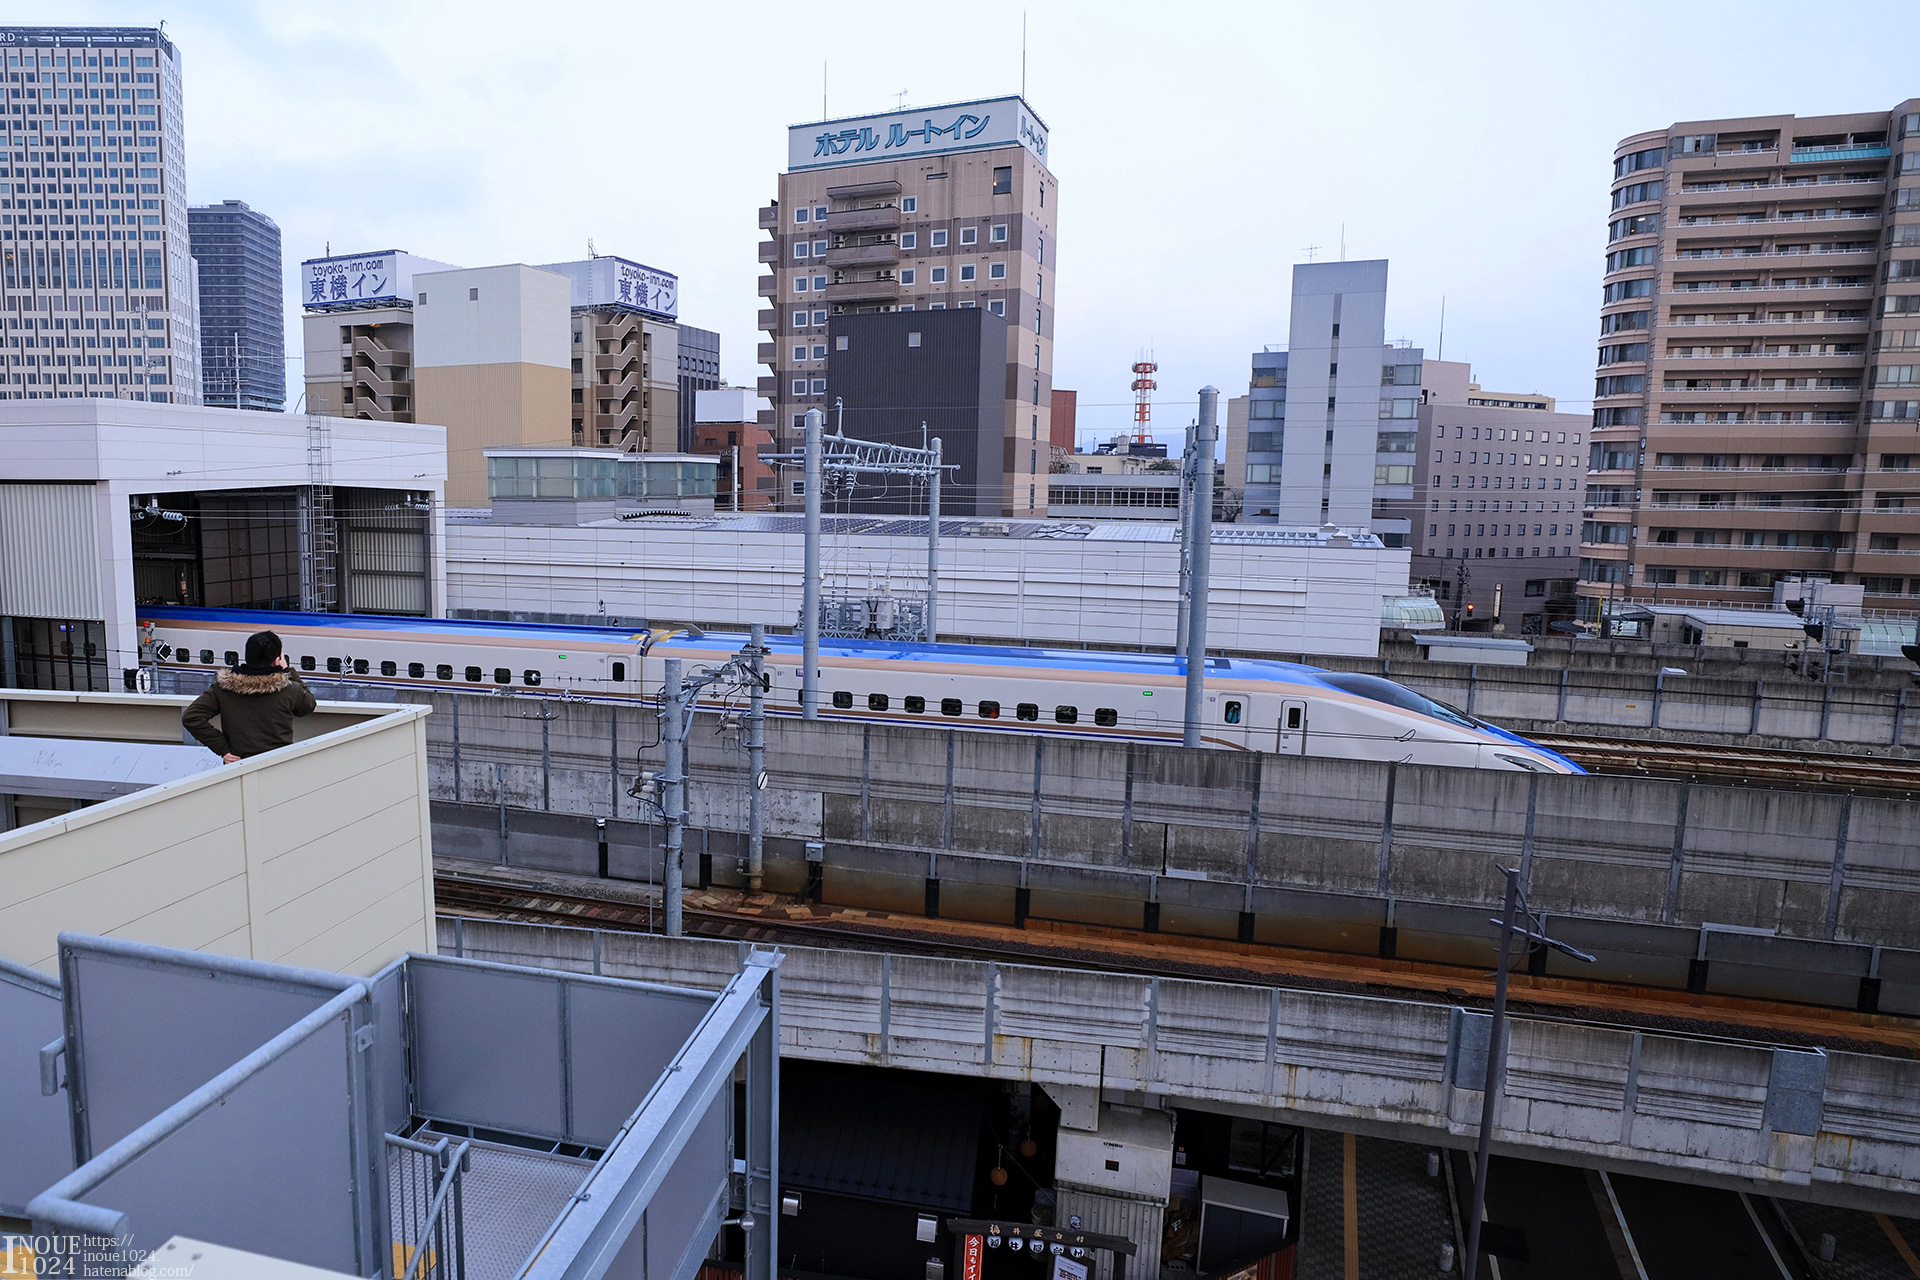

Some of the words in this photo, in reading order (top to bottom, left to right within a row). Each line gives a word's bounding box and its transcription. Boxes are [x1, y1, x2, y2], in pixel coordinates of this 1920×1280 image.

[814, 126, 880, 158] ホテル
[885, 114, 990, 149] ルートイン
[312, 259, 384, 277] toyoko-inn.com
[621, 264, 674, 290] toyoko-inn.com
[310, 273, 388, 302] 東横イン
[618, 278, 677, 312] 東横イン
